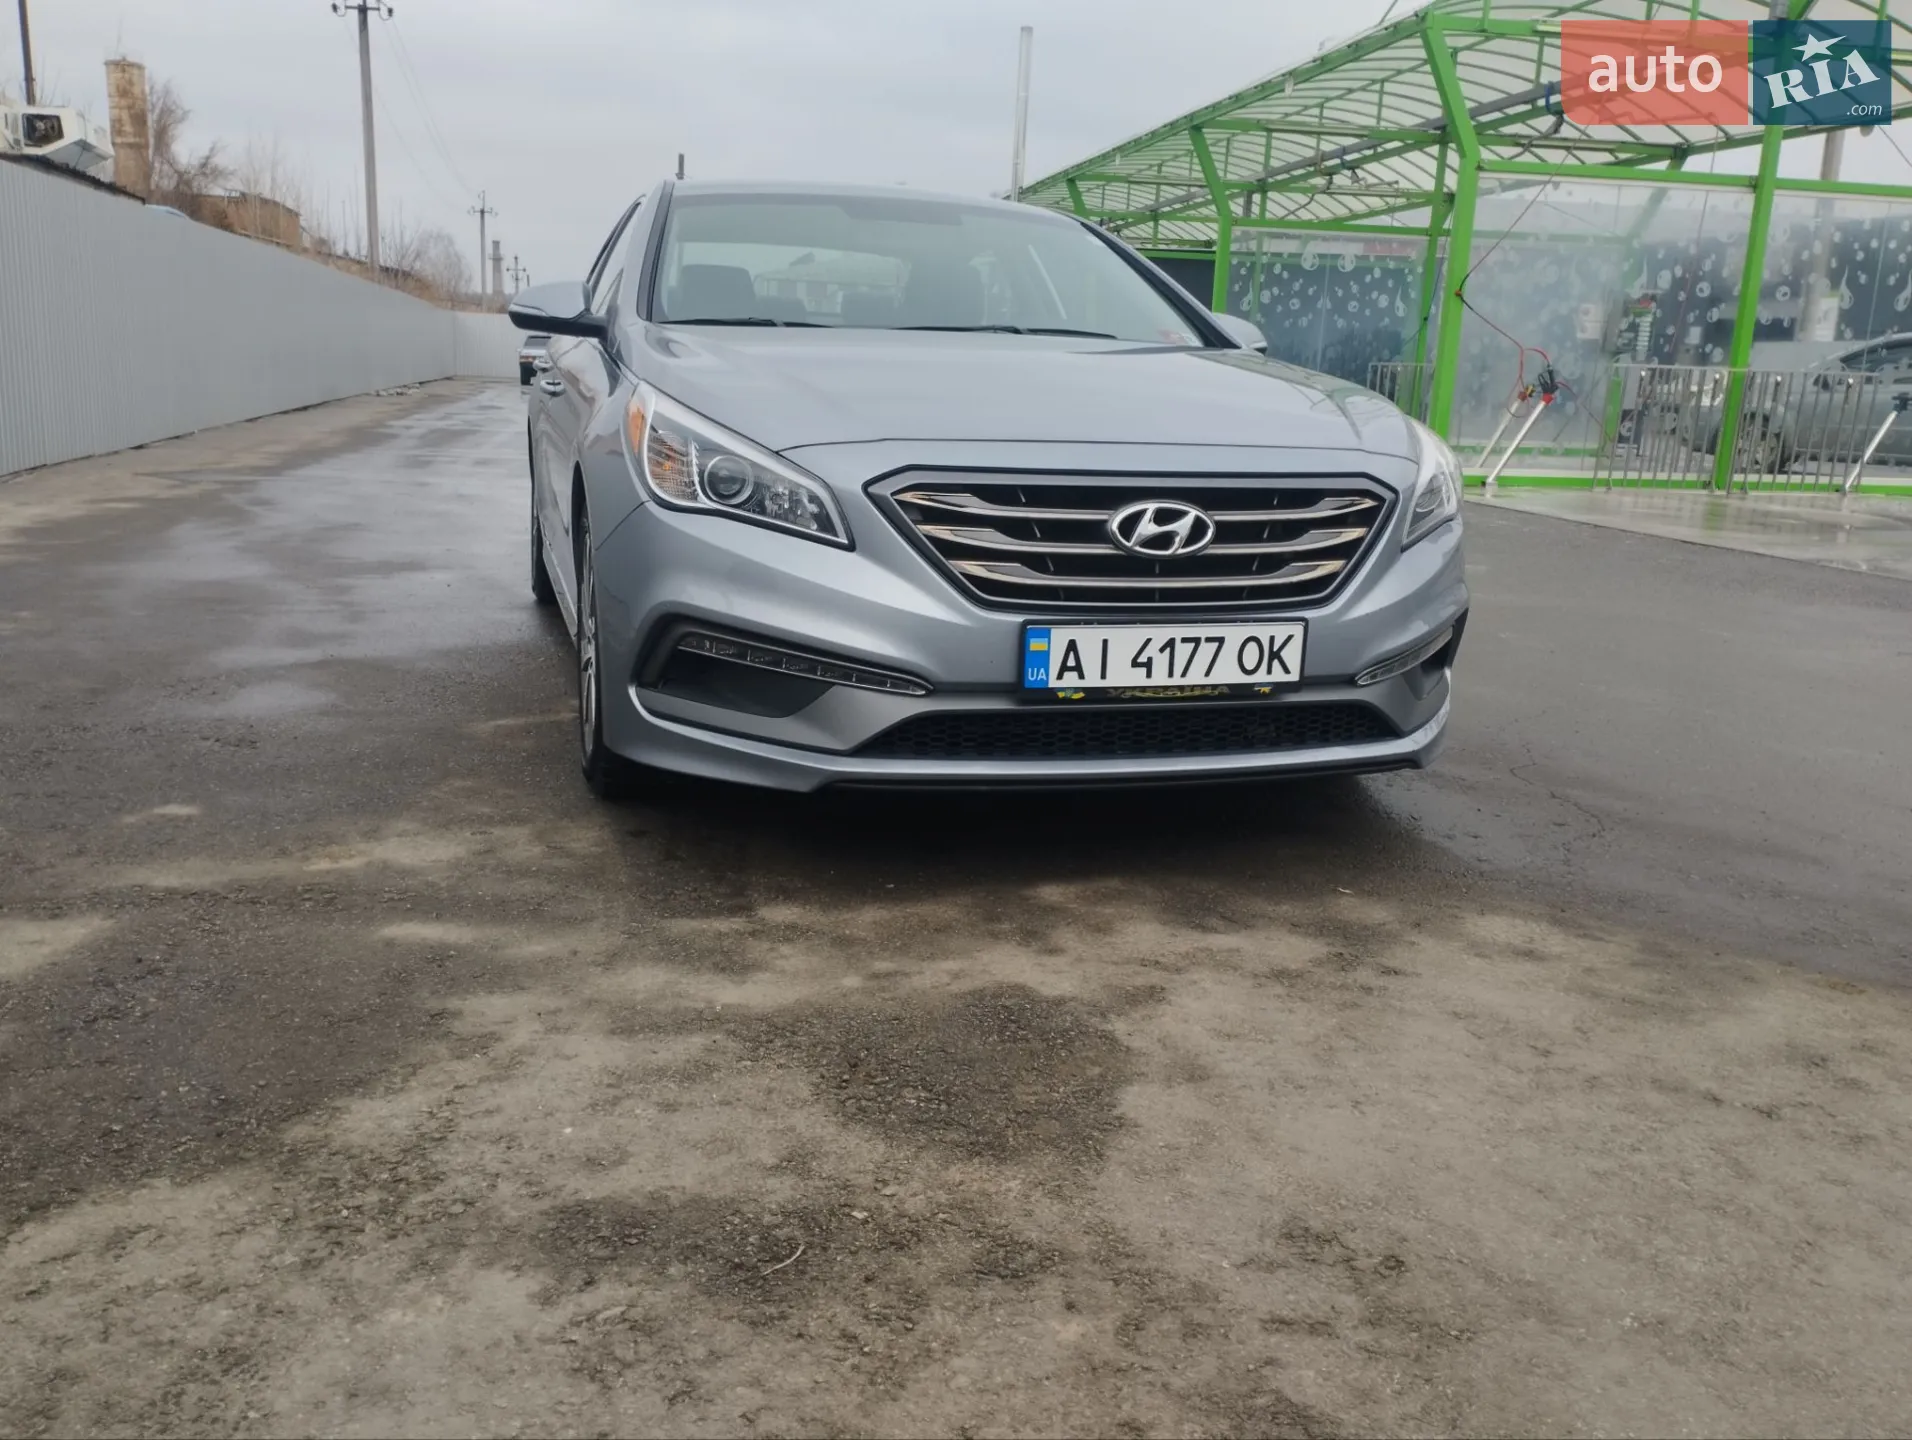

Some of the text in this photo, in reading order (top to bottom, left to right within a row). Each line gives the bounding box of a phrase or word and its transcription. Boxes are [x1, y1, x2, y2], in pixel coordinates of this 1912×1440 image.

[1131, 637, 1226, 679] 4177
[1237, 633, 1295, 676] OK
[1028, 667, 1047, 681] UA
